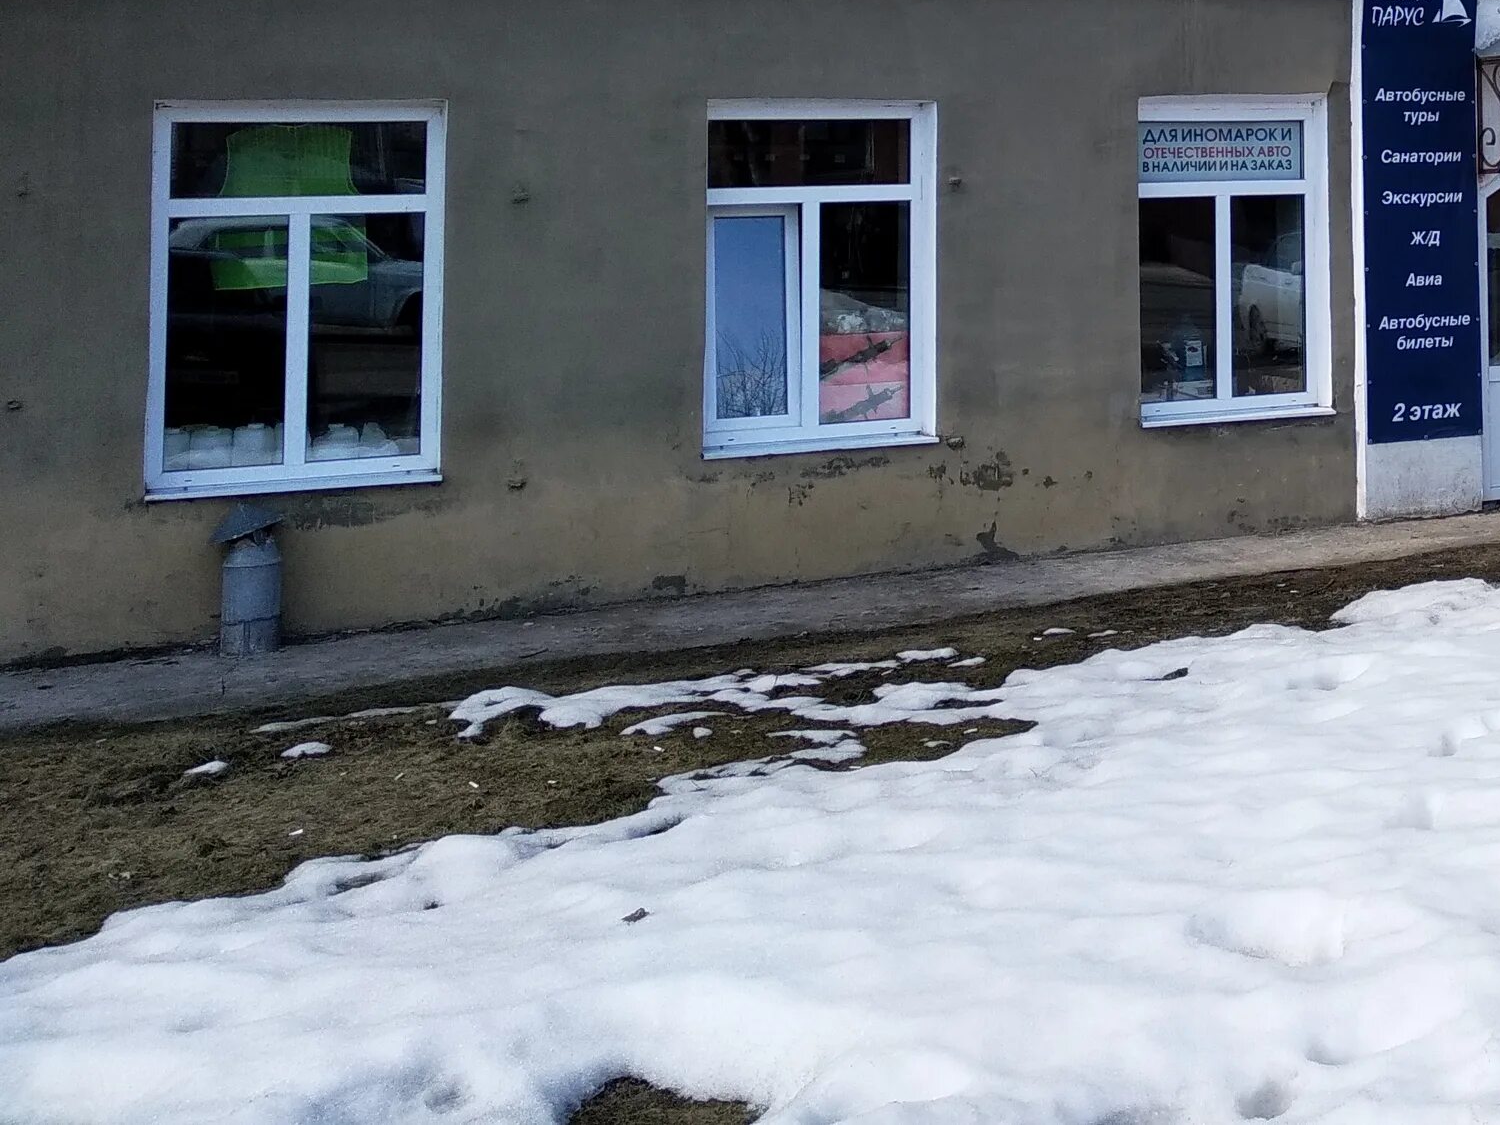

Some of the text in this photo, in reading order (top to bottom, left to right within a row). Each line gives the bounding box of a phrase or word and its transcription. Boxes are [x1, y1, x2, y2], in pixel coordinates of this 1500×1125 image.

[1371, 6, 1425, 27] ПАРУС
[1375, 88, 1466, 103] Автобусные
[1403, 109, 1440, 125] туры
[1143, 128, 1292, 145] ДЛЯ ИНОМАРОК И
[1144, 146, 1291, 159] ОТЕЧЕСТВЕННЫХ АВТО
[1381, 149, 1462, 165] Санатории
[1142, 159, 1292, 173] В НАЛИЧИИ И НА ЗАКАЗ
[1381, 190, 1462, 207] Экскурсии
[1410, 230, 1441, 246] Ж/Д
[1405, 273, 1443, 287] Авиа
[1378, 313, 1471, 332] Автобусные
[1397, 335, 1454, 350] билеты
[1392, 402, 1462, 422] 2 этаж
